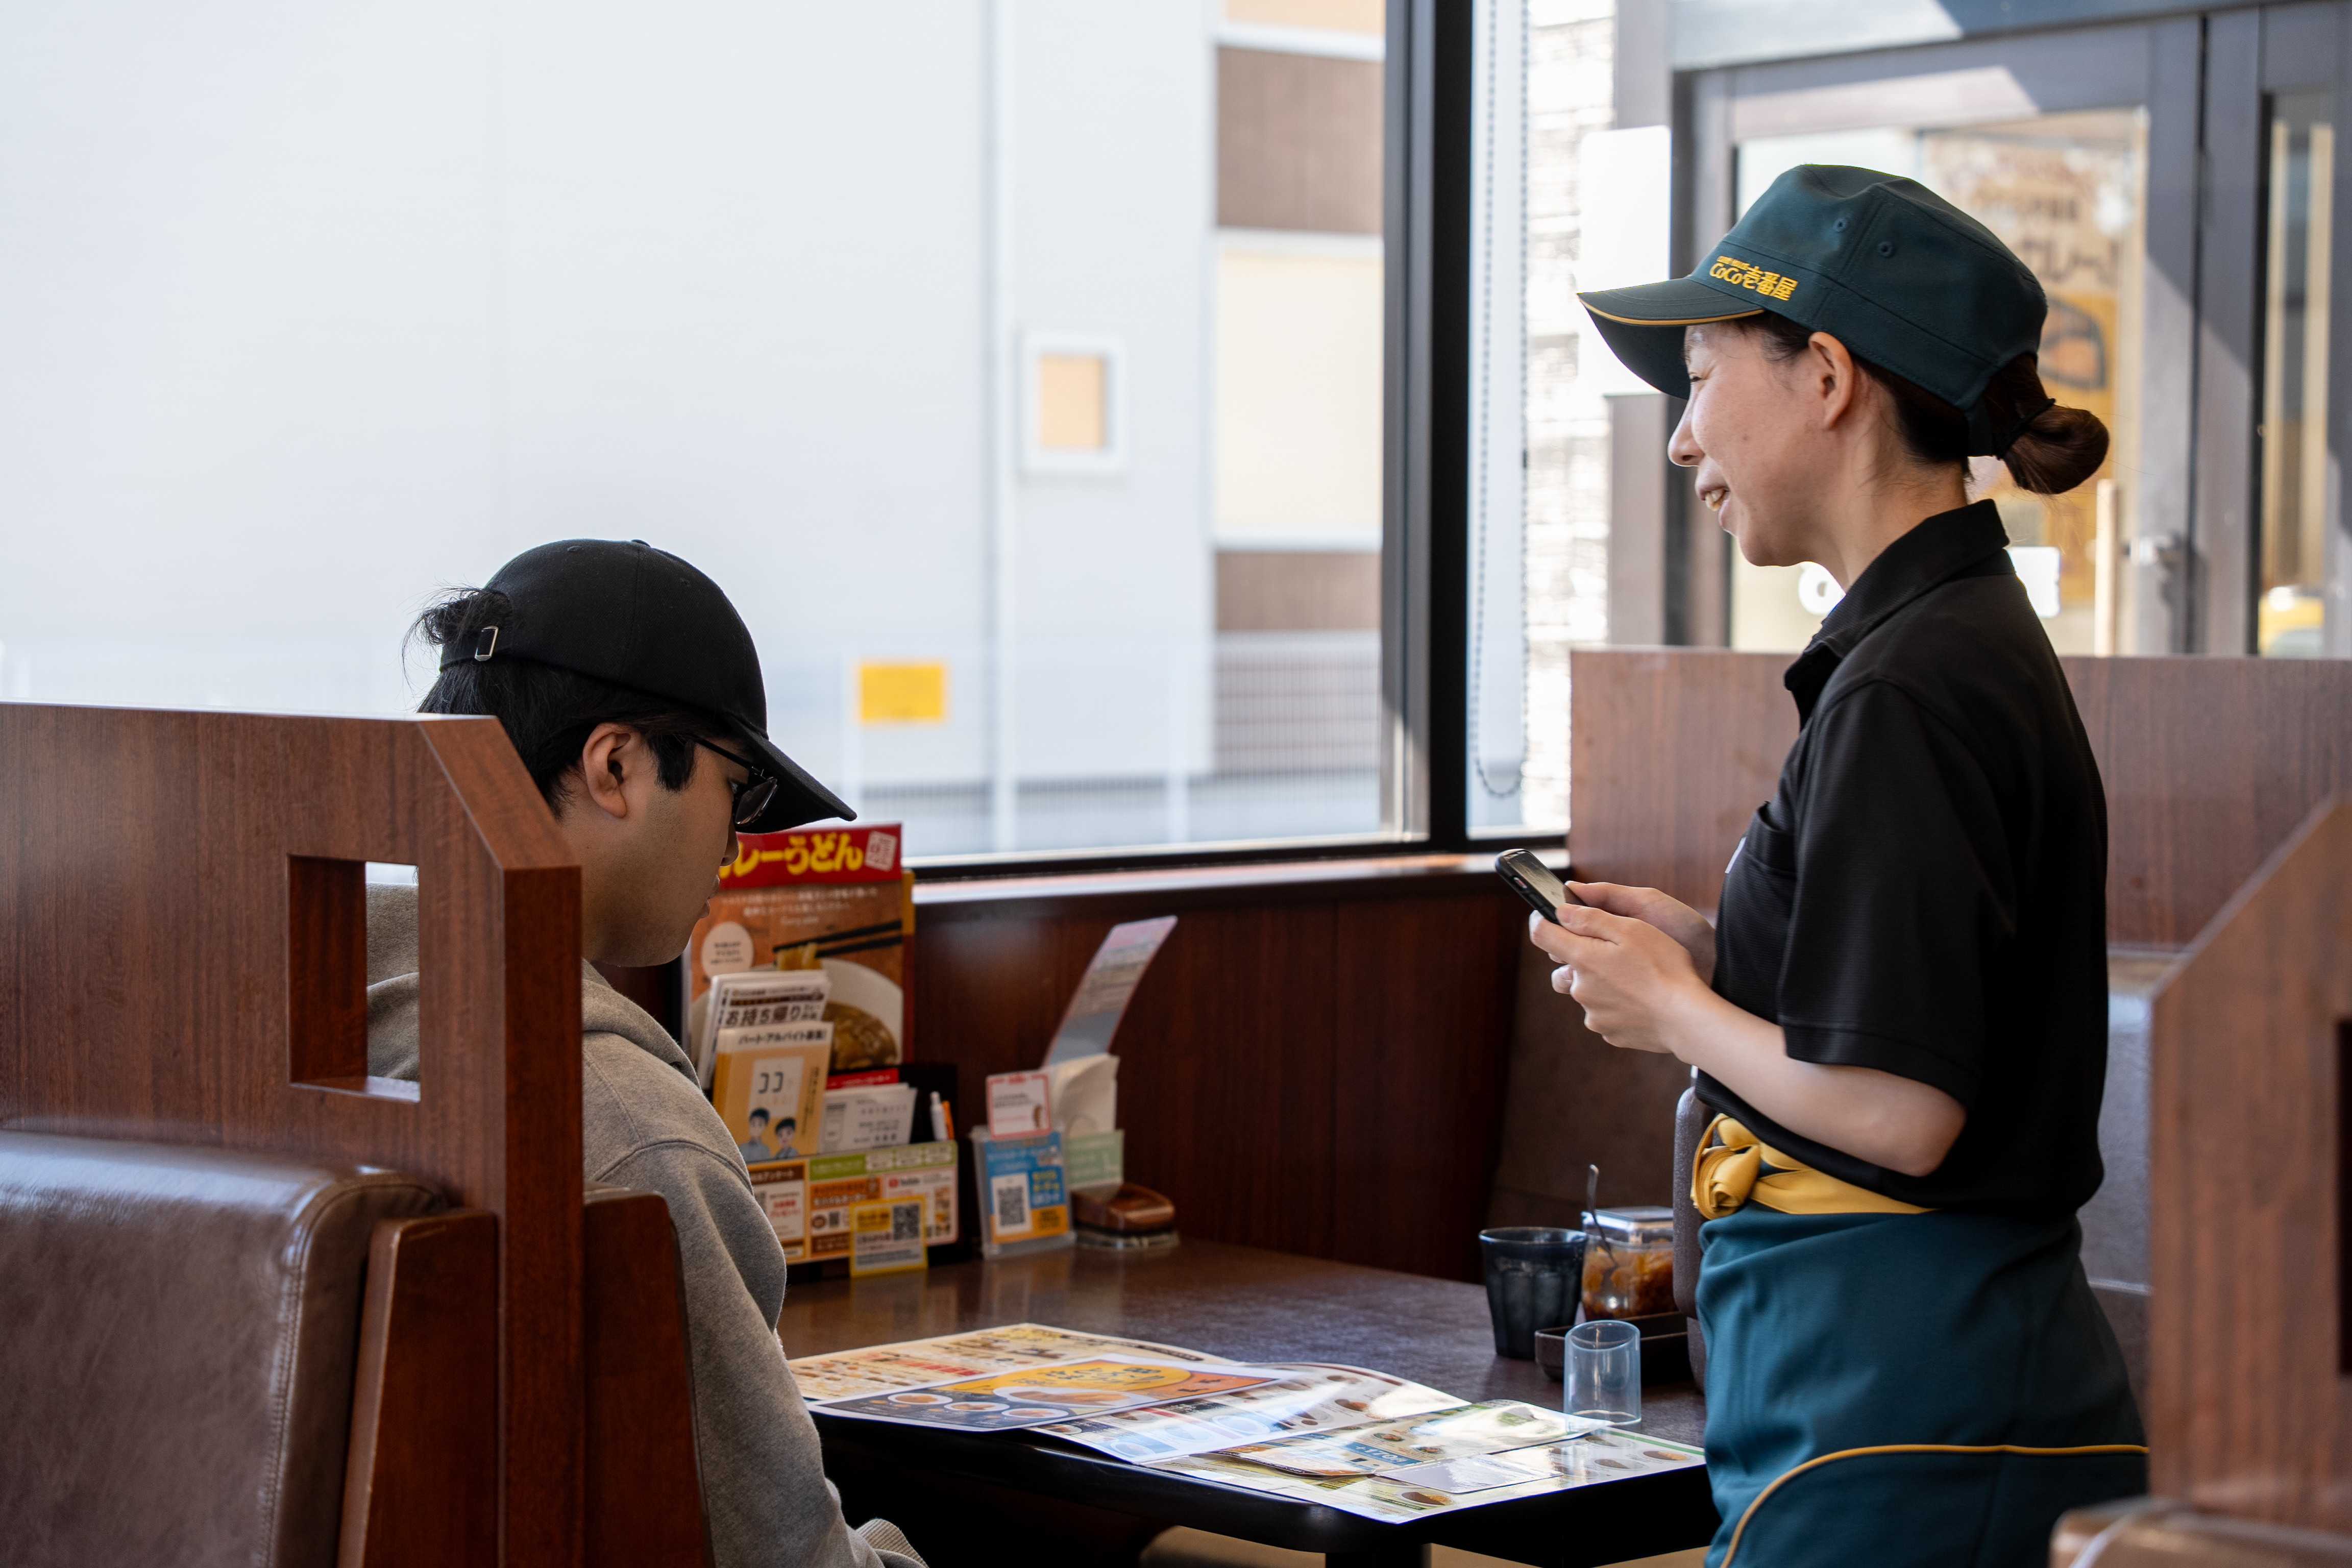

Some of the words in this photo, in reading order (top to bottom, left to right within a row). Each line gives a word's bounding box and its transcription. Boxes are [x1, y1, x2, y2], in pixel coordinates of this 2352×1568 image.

[719, 832, 864, 879] レーうどん
